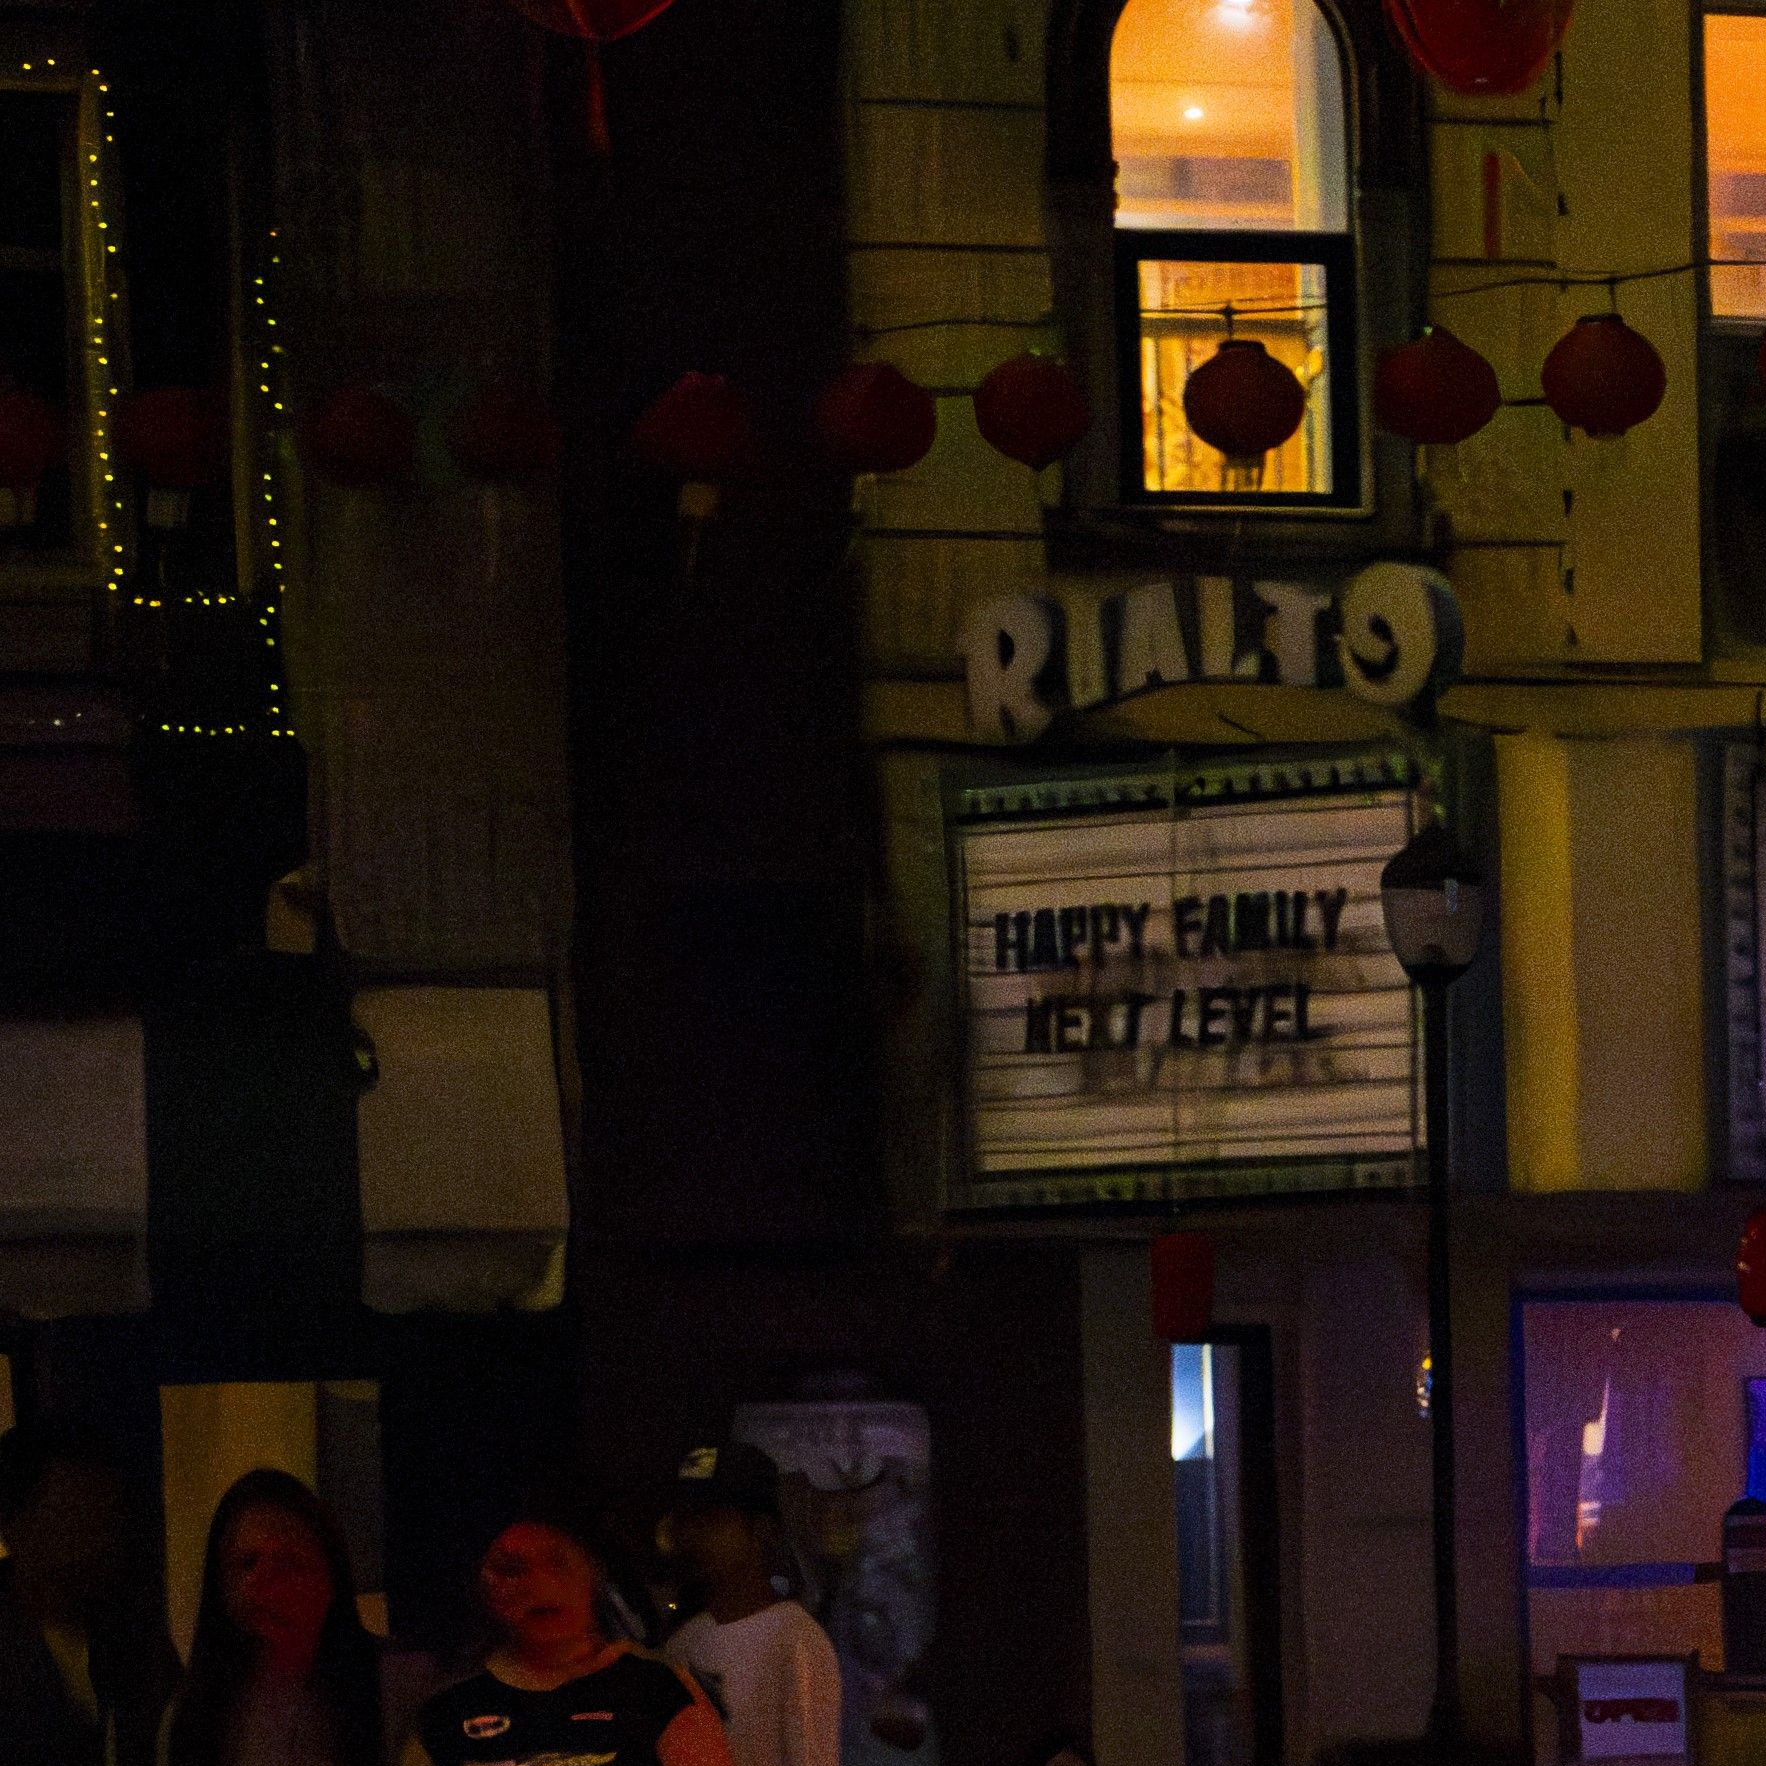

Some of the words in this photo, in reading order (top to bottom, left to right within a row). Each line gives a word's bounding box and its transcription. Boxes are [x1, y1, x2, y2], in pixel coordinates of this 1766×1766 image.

[961, 560, 1452, 746] RIALTO
[996, 903, 1149, 971] HAPPY
[1174, 888, 1346, 958] FAMILY
[1025, 994, 1153, 1053] NEXT
[1170, 984, 1318, 1048] LEVEL
